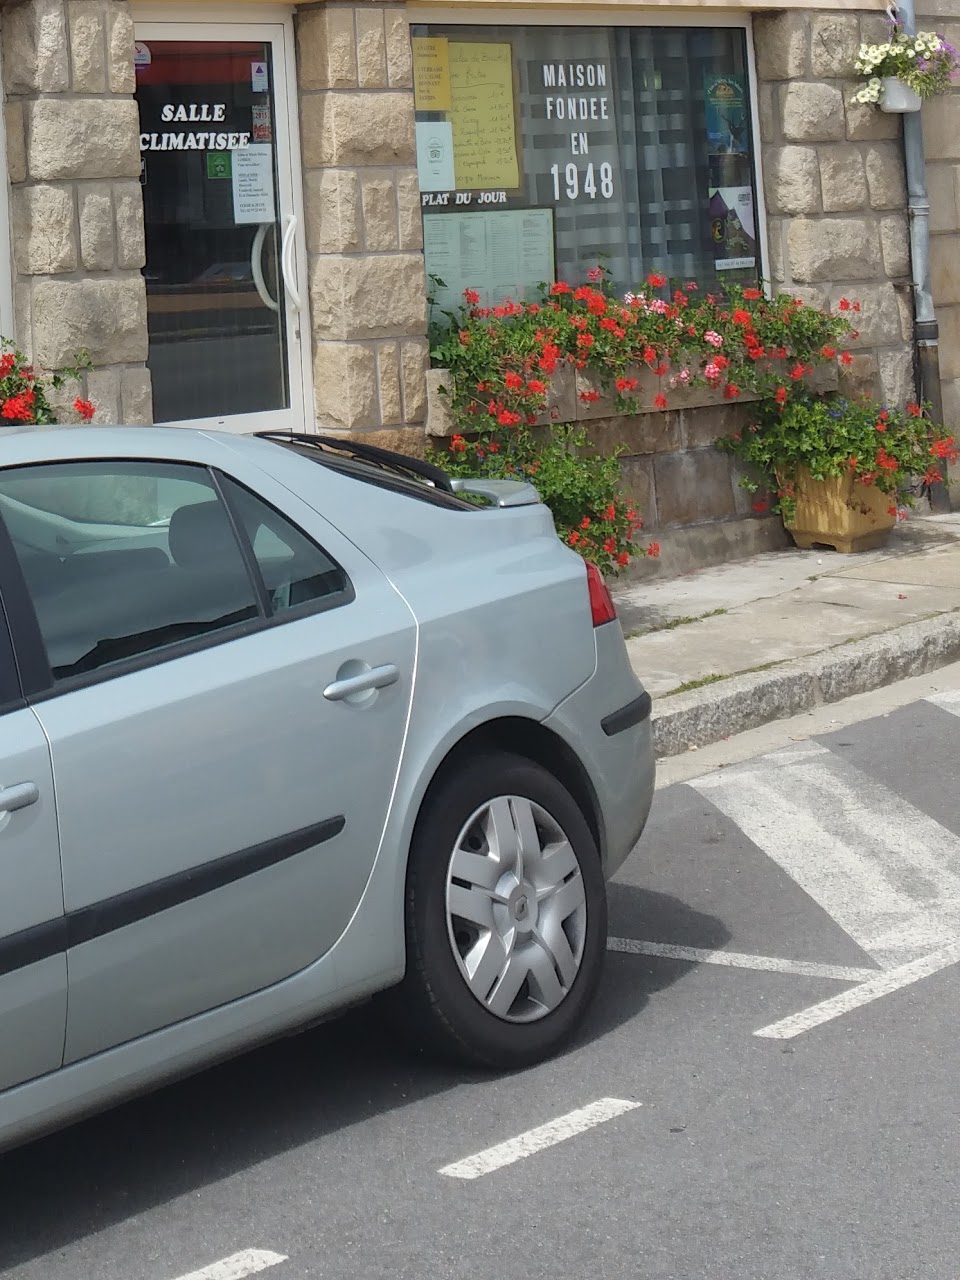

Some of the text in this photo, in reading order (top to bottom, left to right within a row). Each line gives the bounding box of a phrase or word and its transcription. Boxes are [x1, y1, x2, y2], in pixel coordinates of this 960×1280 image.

[543, 64, 607, 87] MAISON
[161, 104, 226, 122] SALLE
[546, 97, 609, 120] FONDEE
[139, 131, 251, 151] CLIMATISEE
[570, 132, 589, 155] EN
[550, 161, 614, 201] 1948
[421, 191, 507, 207] PLAT DU JOUR
